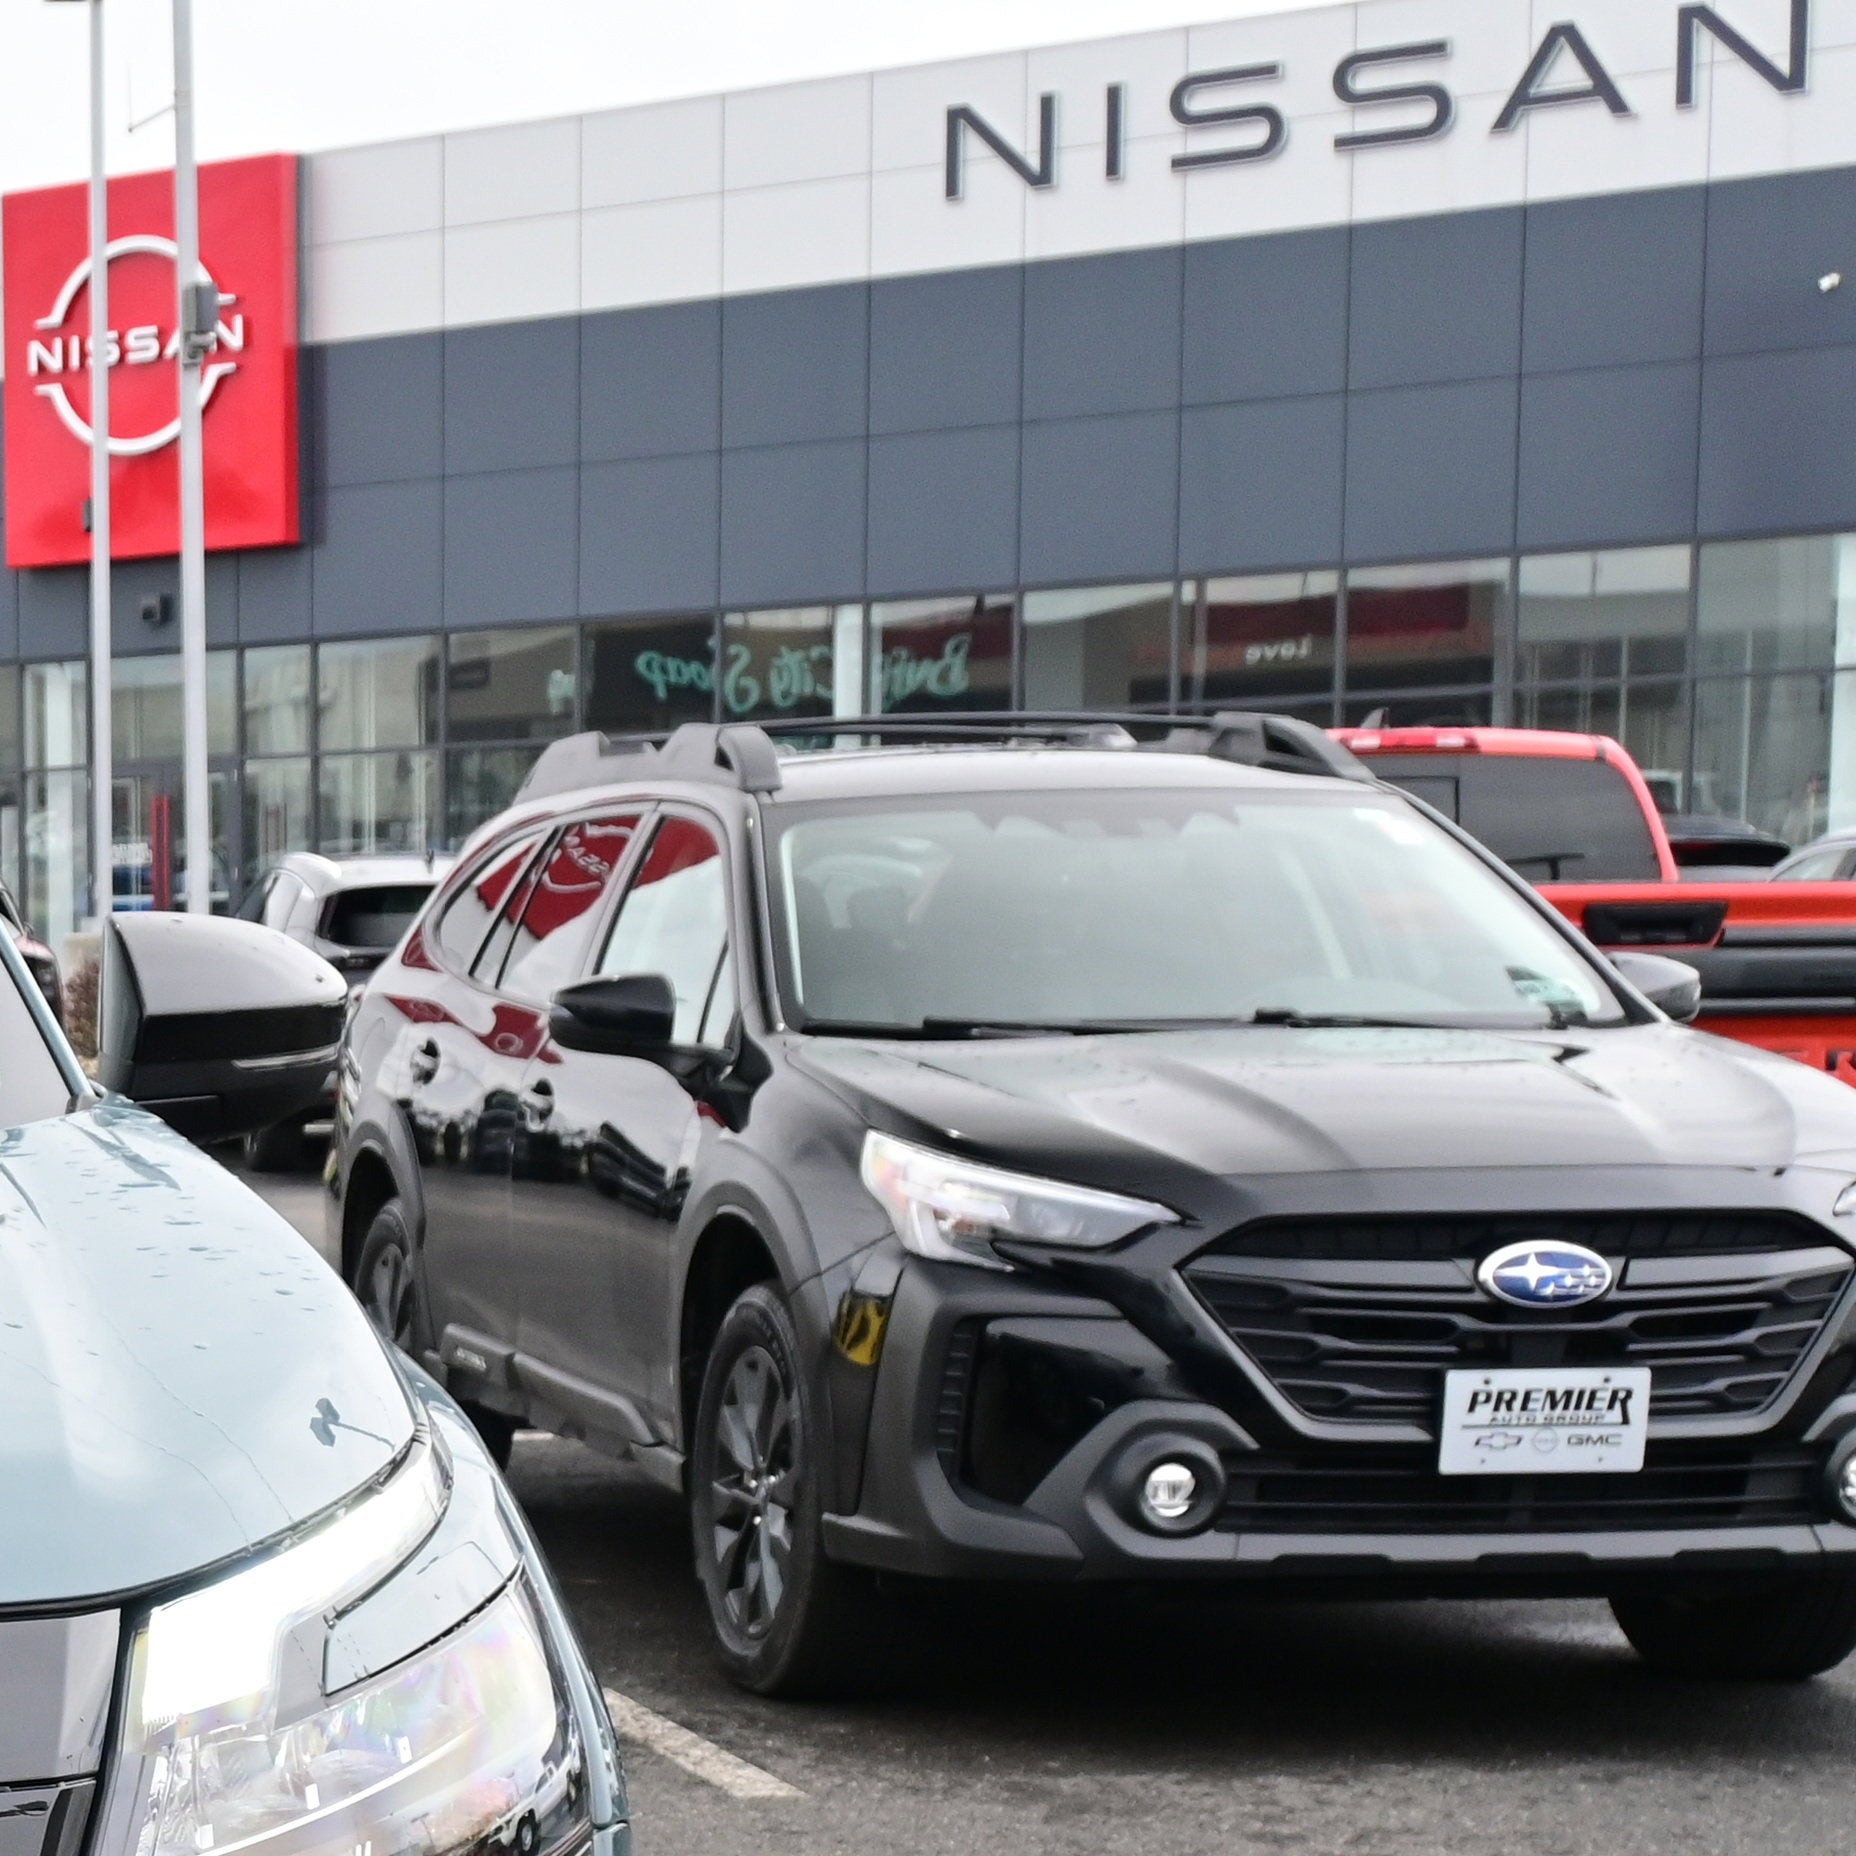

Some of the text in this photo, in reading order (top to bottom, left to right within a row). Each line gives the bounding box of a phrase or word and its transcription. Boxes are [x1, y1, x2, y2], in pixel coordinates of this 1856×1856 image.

[945, 0, 1810, 200] NISSAN
[1466, 1386, 1635, 1424] PREMIER
[1488, 1414, 1606, 1425] AUTO GROUP
[1567, 1433, 1623, 1446] GMC
